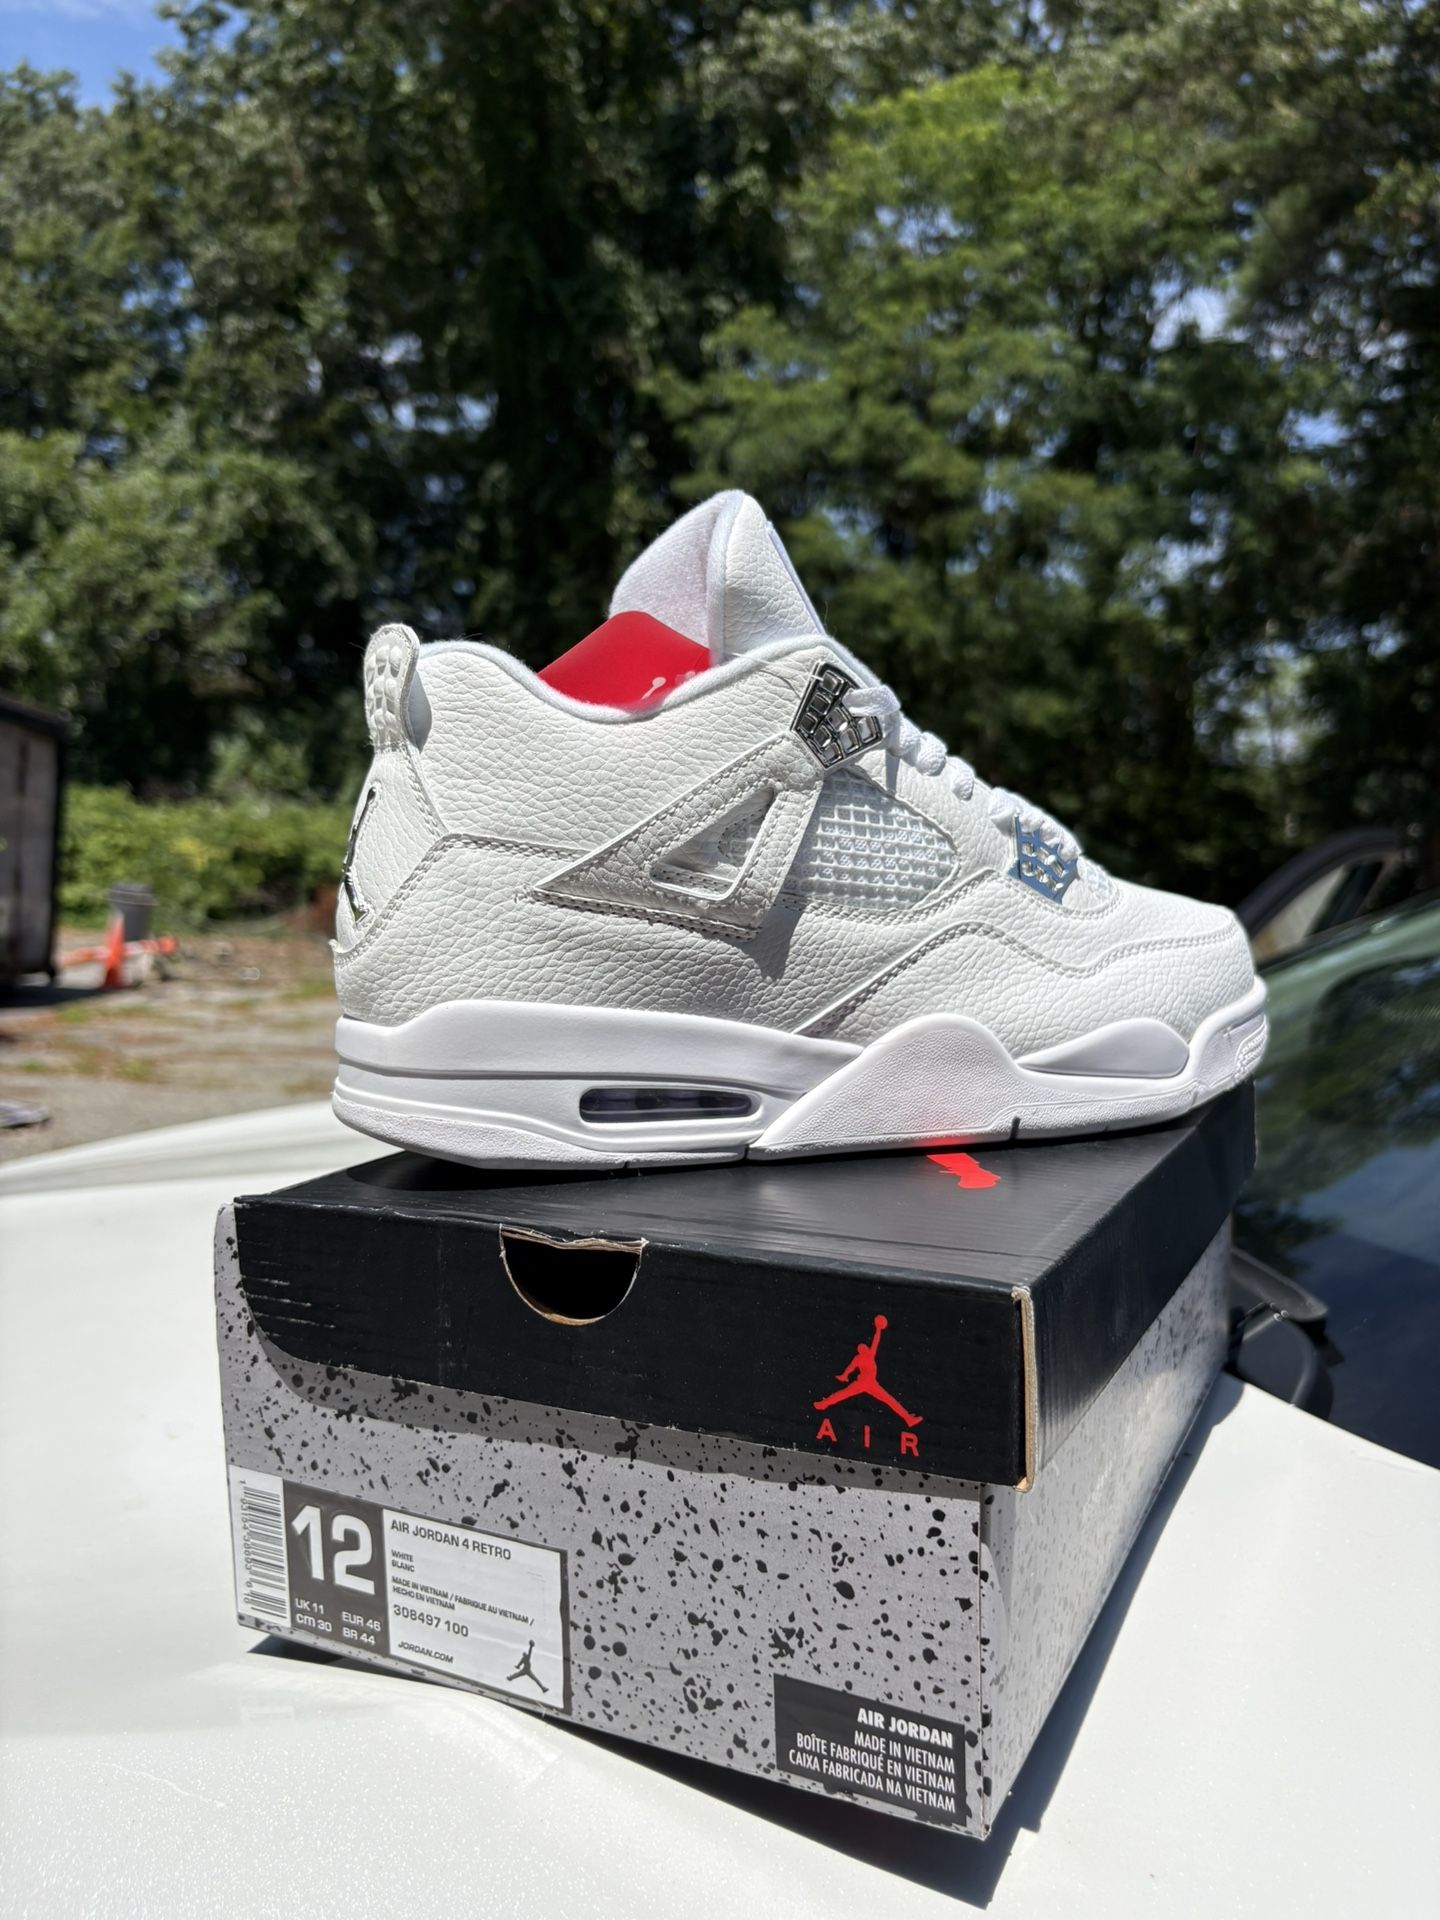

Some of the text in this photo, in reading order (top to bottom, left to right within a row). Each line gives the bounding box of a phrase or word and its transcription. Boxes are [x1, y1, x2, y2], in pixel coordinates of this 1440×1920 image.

[816, 1418, 920, 1457] AIR
[291, 1504, 376, 1596] 12
[391, 1520, 511, 1560] AIR JORDAN 4 RETRO
[391, 1549, 414, 1562] WHITE
[392, 1560, 415, 1572] BLANC
[295, 1598, 325, 1614] UK 11
[392, 1586, 455, 1610] HECHO EN VIETNAM
[392, 1576, 410, 1588] MADE
[412, 1581, 419, 1590] IN
[420, 1584, 449, 1599] VIETNAM
[488, 1605, 498, 1615] AU
[498, 1608, 529, 1623] VIETNAM
[317, 1619, 332, 1632] 30
[342, 1611, 381, 1631] EUR 46
[342, 1627, 376, 1645] BR 44
[393, 1604, 469, 1637] 308497 100
[398, 1641, 453, 1663] JORDAN.COM
[857, 1707, 953, 1749] AIR JORDAN
[797, 1732, 955, 1794] BOÎTE FABRIQUÉ EN VIETNAM
[854, 1730, 955, 1774] MADE IN VIETNAM
[789, 1749, 956, 1813] CAIXA FABRICADA NA VIETNAM
